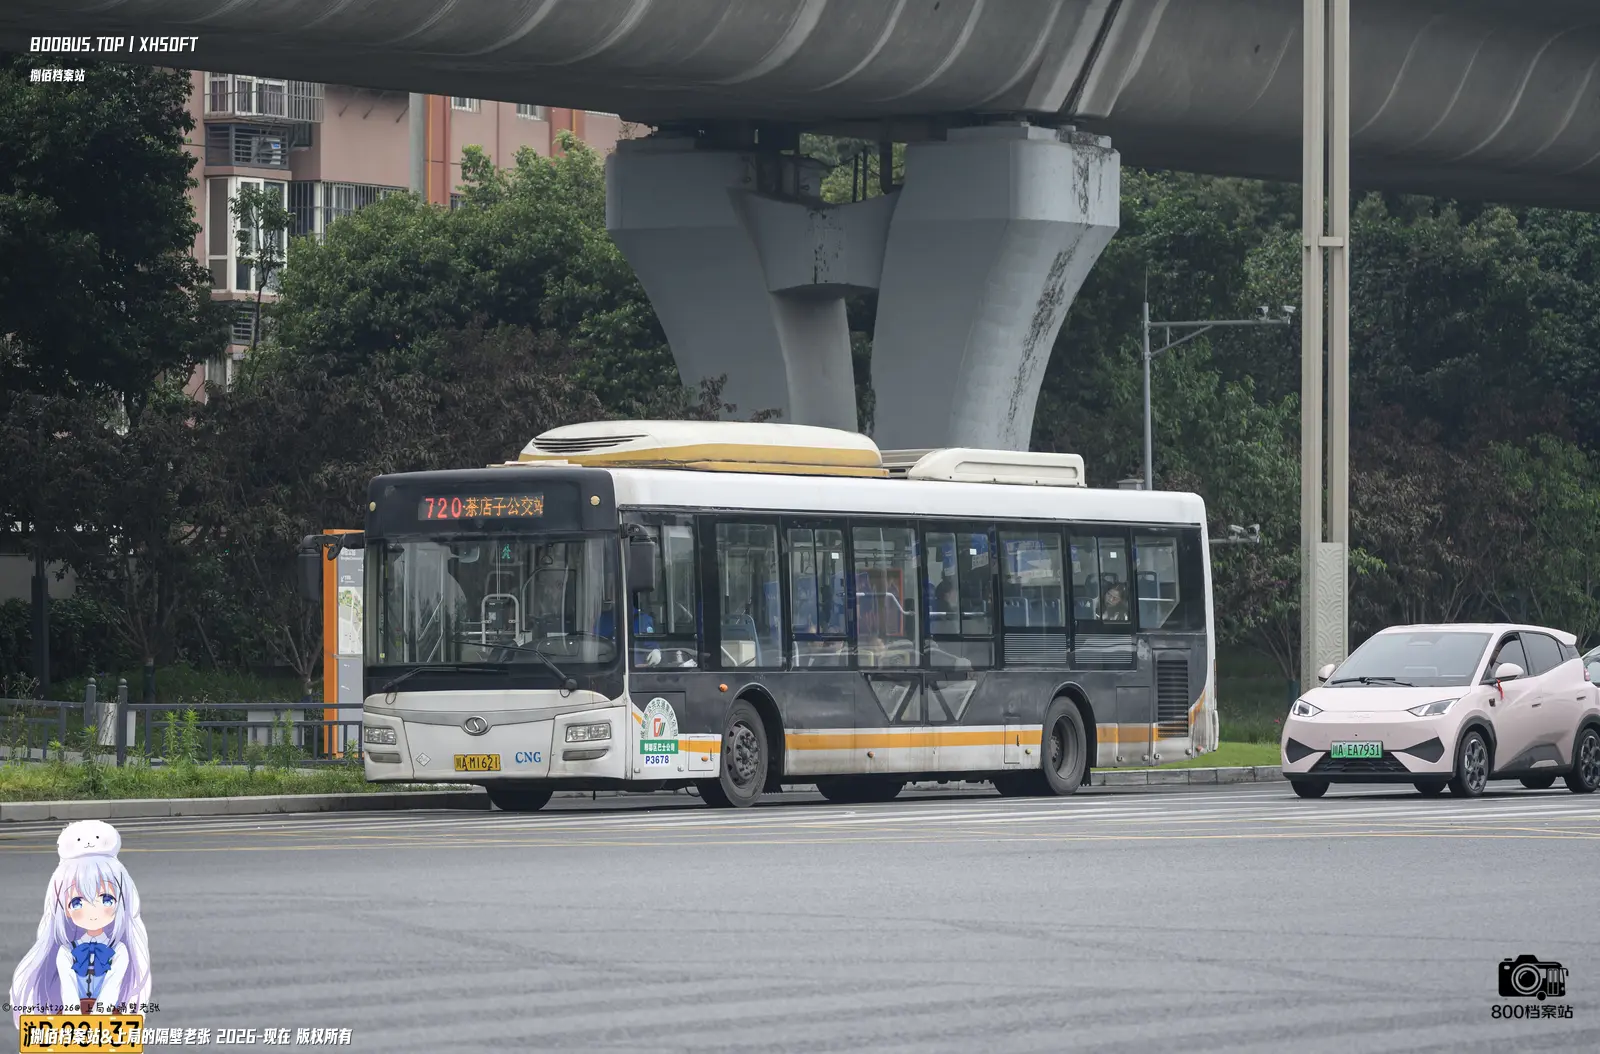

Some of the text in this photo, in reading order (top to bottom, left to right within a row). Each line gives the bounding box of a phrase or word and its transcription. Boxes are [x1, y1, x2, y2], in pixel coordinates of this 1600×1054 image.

[425, 497, 462, 519] 720
[515, 751, 542, 764] CNG
[645, 755, 670, 765] P3678
